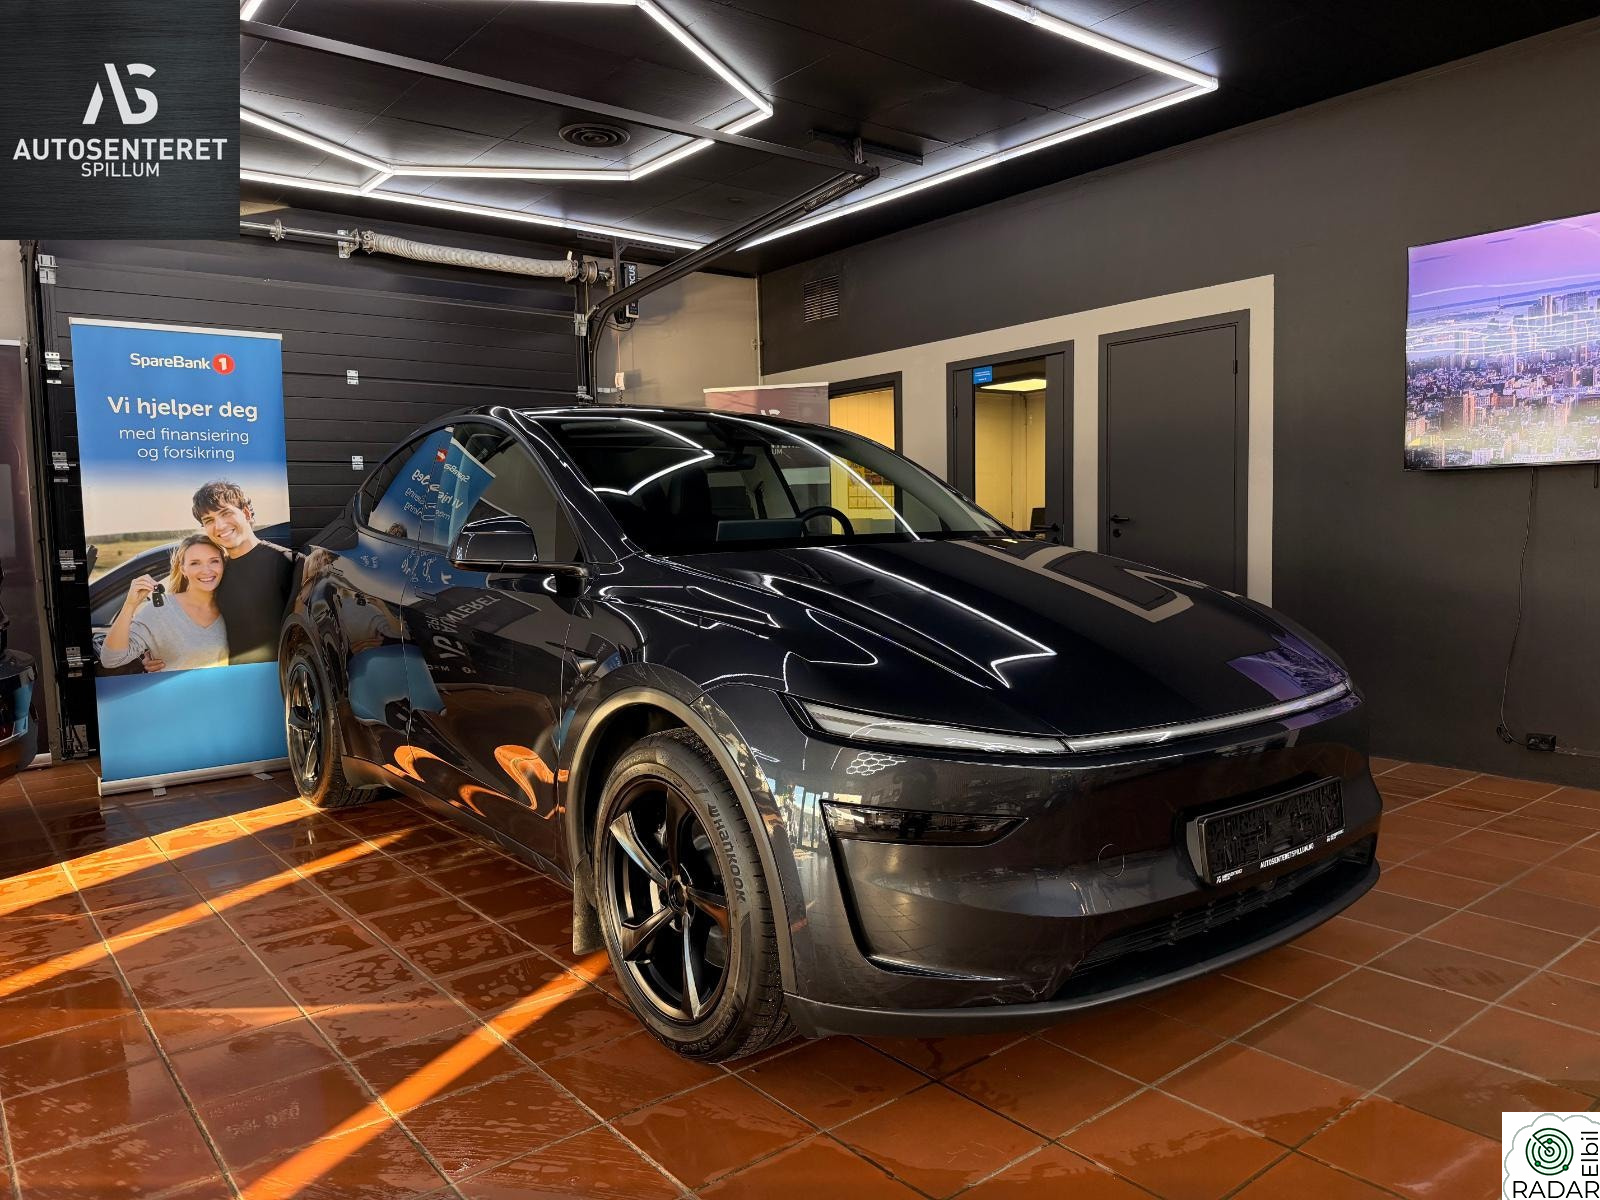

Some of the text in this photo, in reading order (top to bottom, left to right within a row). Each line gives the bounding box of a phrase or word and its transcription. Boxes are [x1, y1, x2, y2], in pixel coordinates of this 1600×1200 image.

[130, 352, 211, 370] SpareBank
[107, 396, 258, 422] Vi hjelper deg
[119, 427, 249, 445] med finansiering
[137, 446, 235, 462] og forsikring
